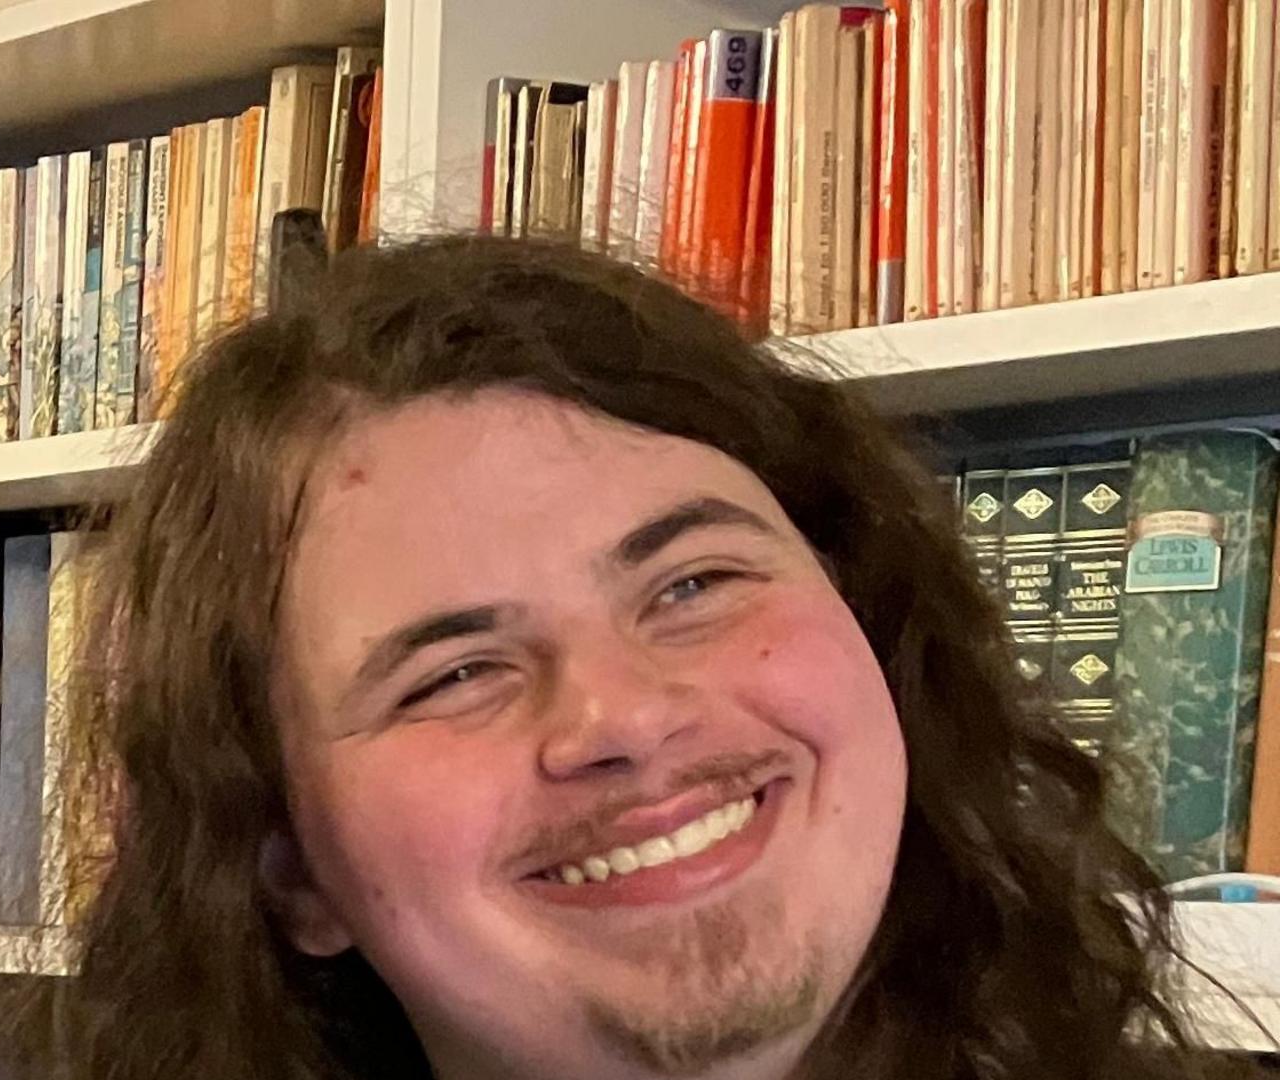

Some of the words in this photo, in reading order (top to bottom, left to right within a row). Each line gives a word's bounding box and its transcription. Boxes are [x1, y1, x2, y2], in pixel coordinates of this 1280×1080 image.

[724, 35, 748, 94] 469
[1149, 537, 1199, 556] LEWIS
[1134, 556, 1209, 575] CARROLL
[1081, 571, 1109, 584] THE
[1067, 584, 1121, 599] ARABIAN
[1071, 598, 1116, 612] NIGHTS
